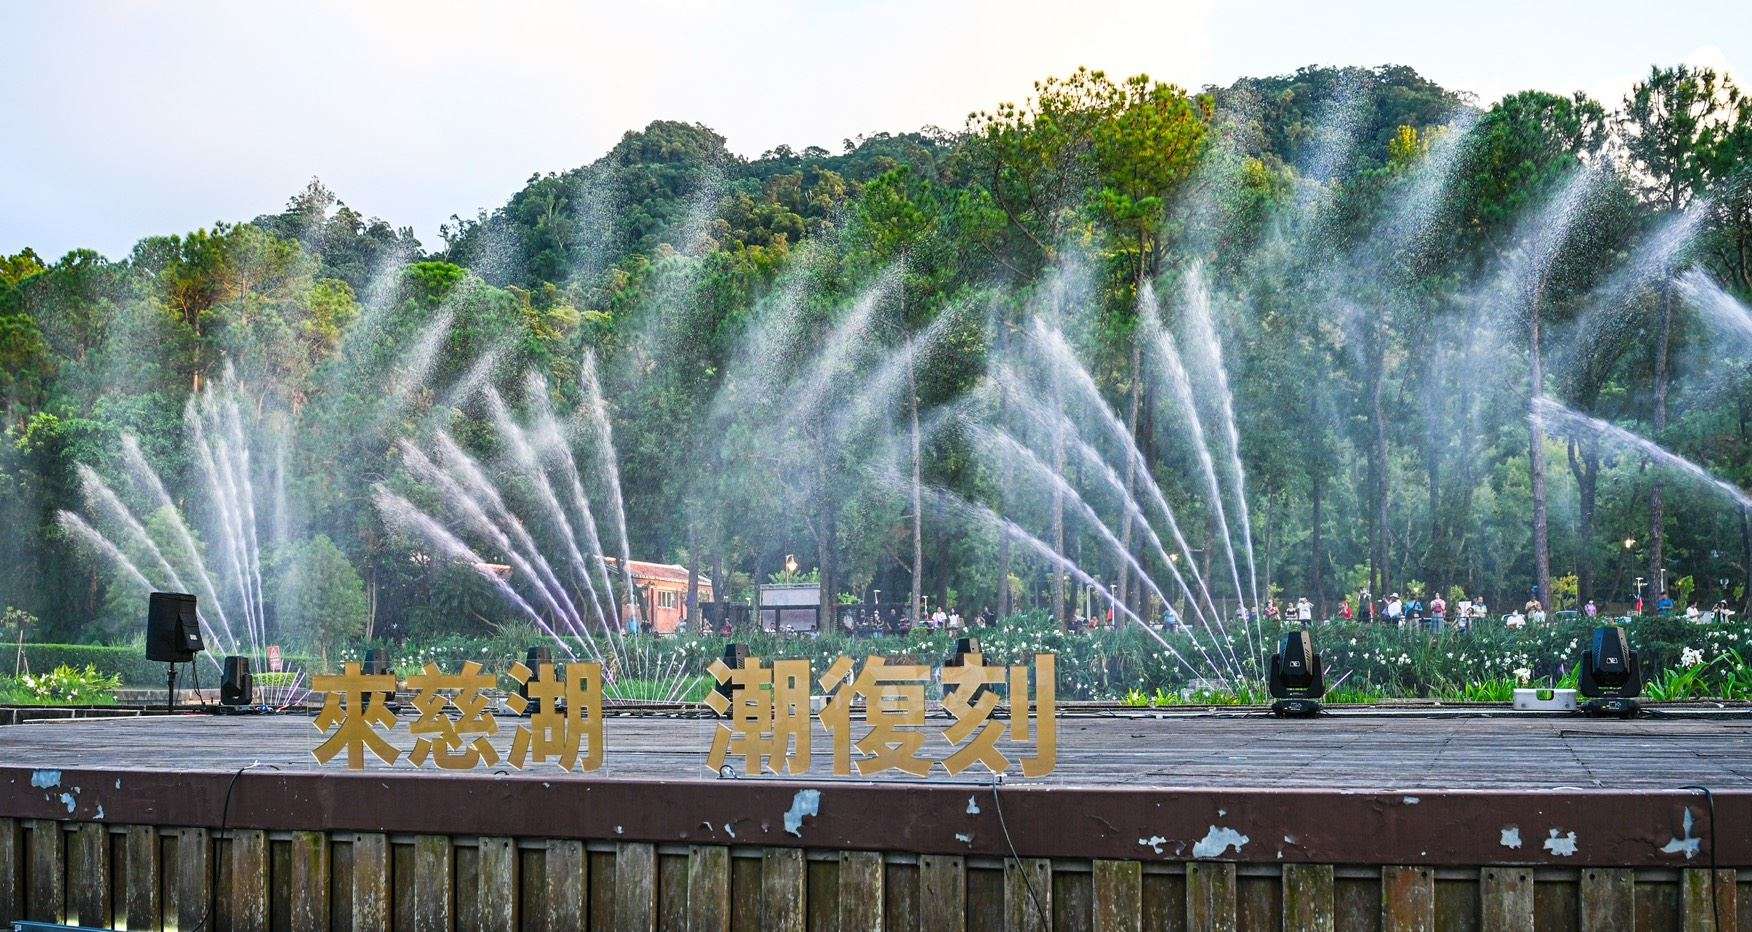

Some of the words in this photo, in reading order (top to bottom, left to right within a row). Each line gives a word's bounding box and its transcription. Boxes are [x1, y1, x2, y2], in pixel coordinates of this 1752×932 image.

[311, 661, 604, 772] 來慈湖
[704, 653, 1056, 778] 潮復刻
